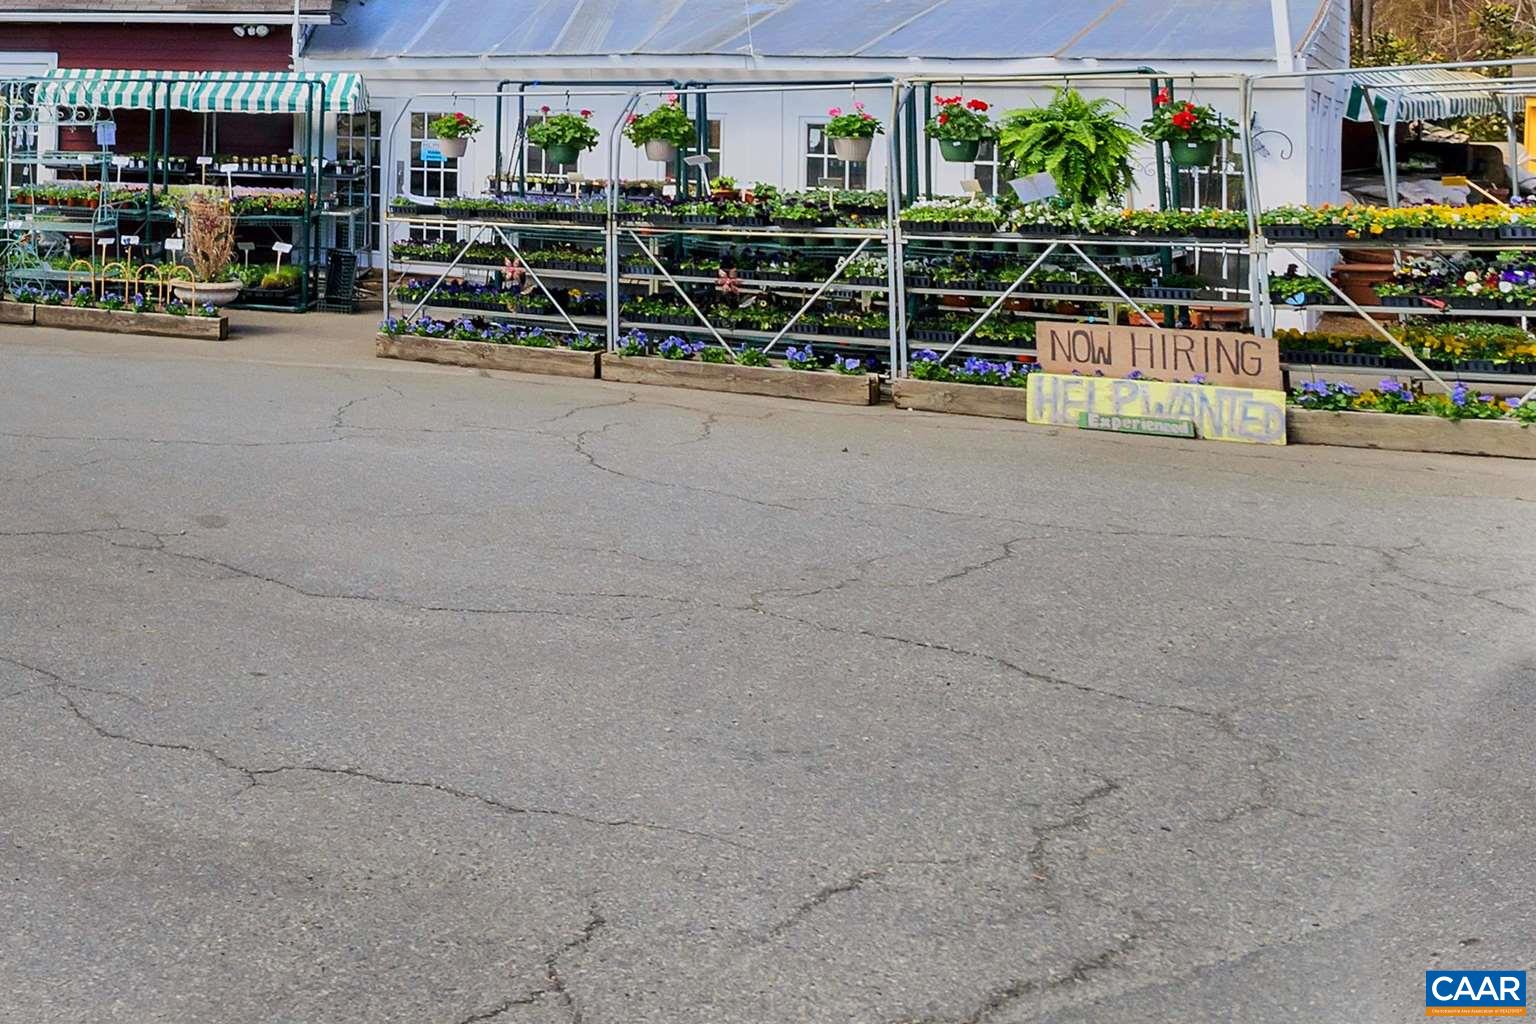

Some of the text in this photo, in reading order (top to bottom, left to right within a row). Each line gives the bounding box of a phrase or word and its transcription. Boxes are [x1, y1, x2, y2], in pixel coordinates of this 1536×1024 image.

[1049, 329, 1263, 377] NOW HIRING
[1034, 375, 1139, 424] HELP
